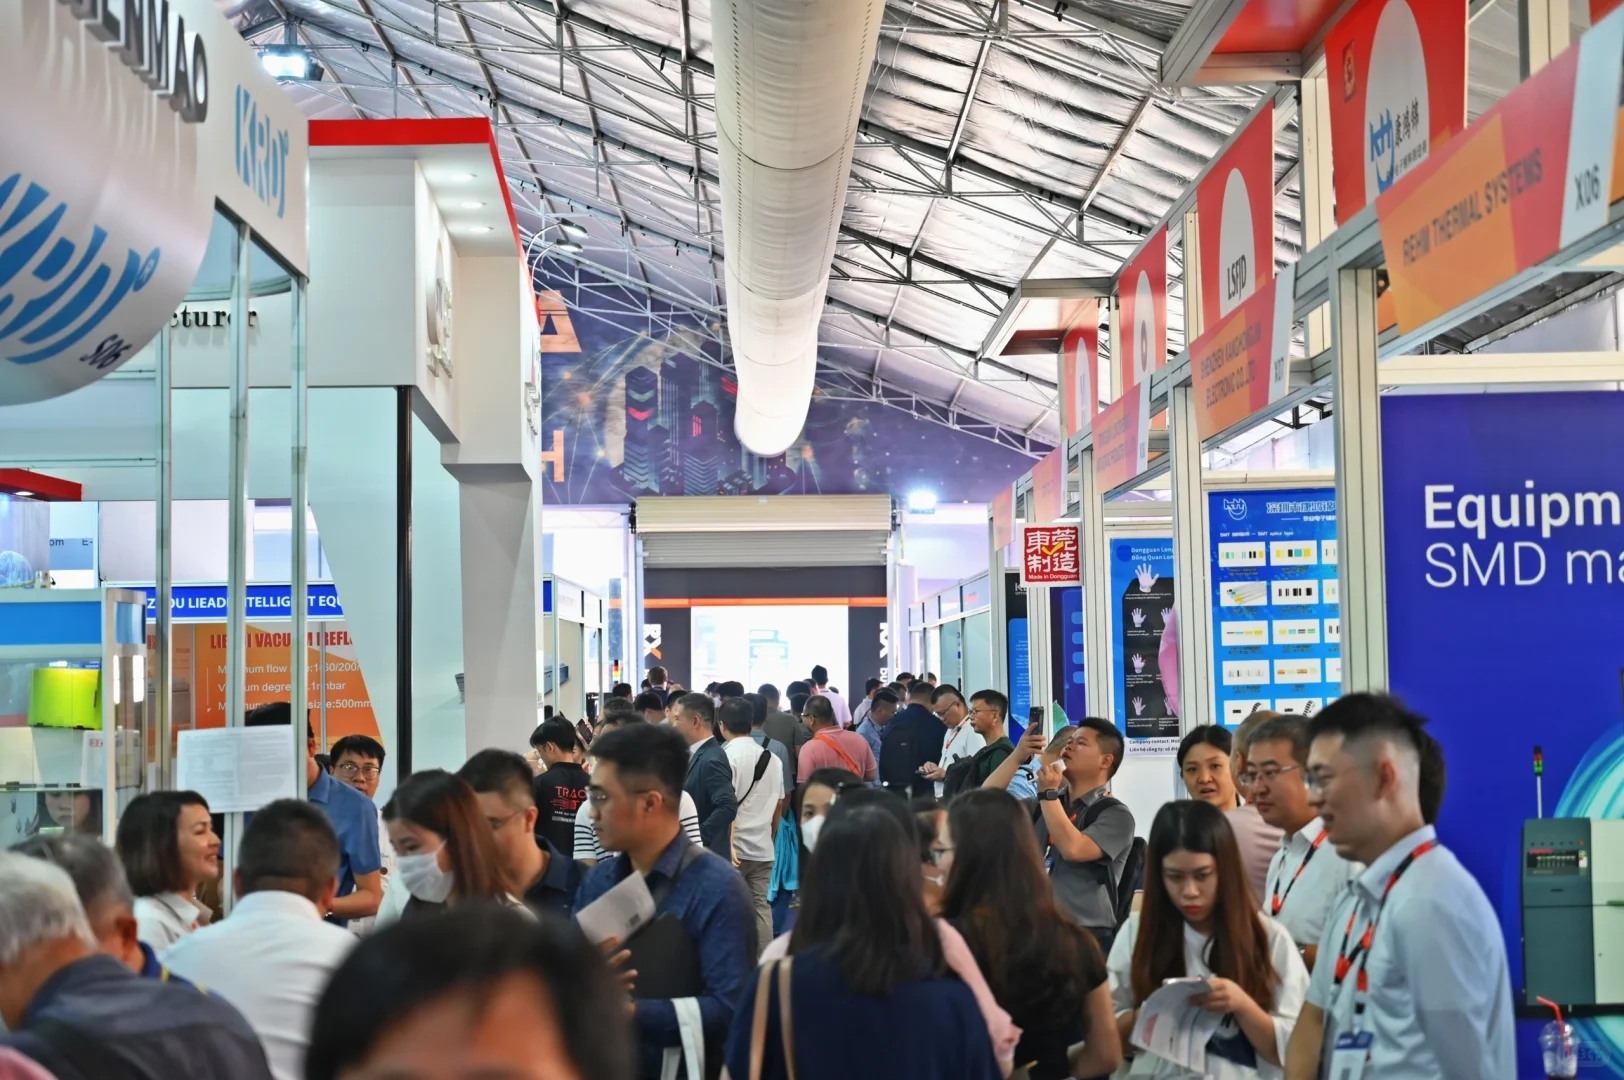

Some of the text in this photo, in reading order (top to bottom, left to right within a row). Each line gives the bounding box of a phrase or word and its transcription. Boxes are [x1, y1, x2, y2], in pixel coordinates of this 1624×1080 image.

[1402, 147, 1544, 268] REHM THERMAL SYSTEMS
[1574, 163, 1601, 212] X06
[1424, 480, 1621, 540] Equipm
[1027, 552, 1078, 573] 制造
[1425, 541, 1546, 588] SMD
[266, 664, 288, 673] flow
